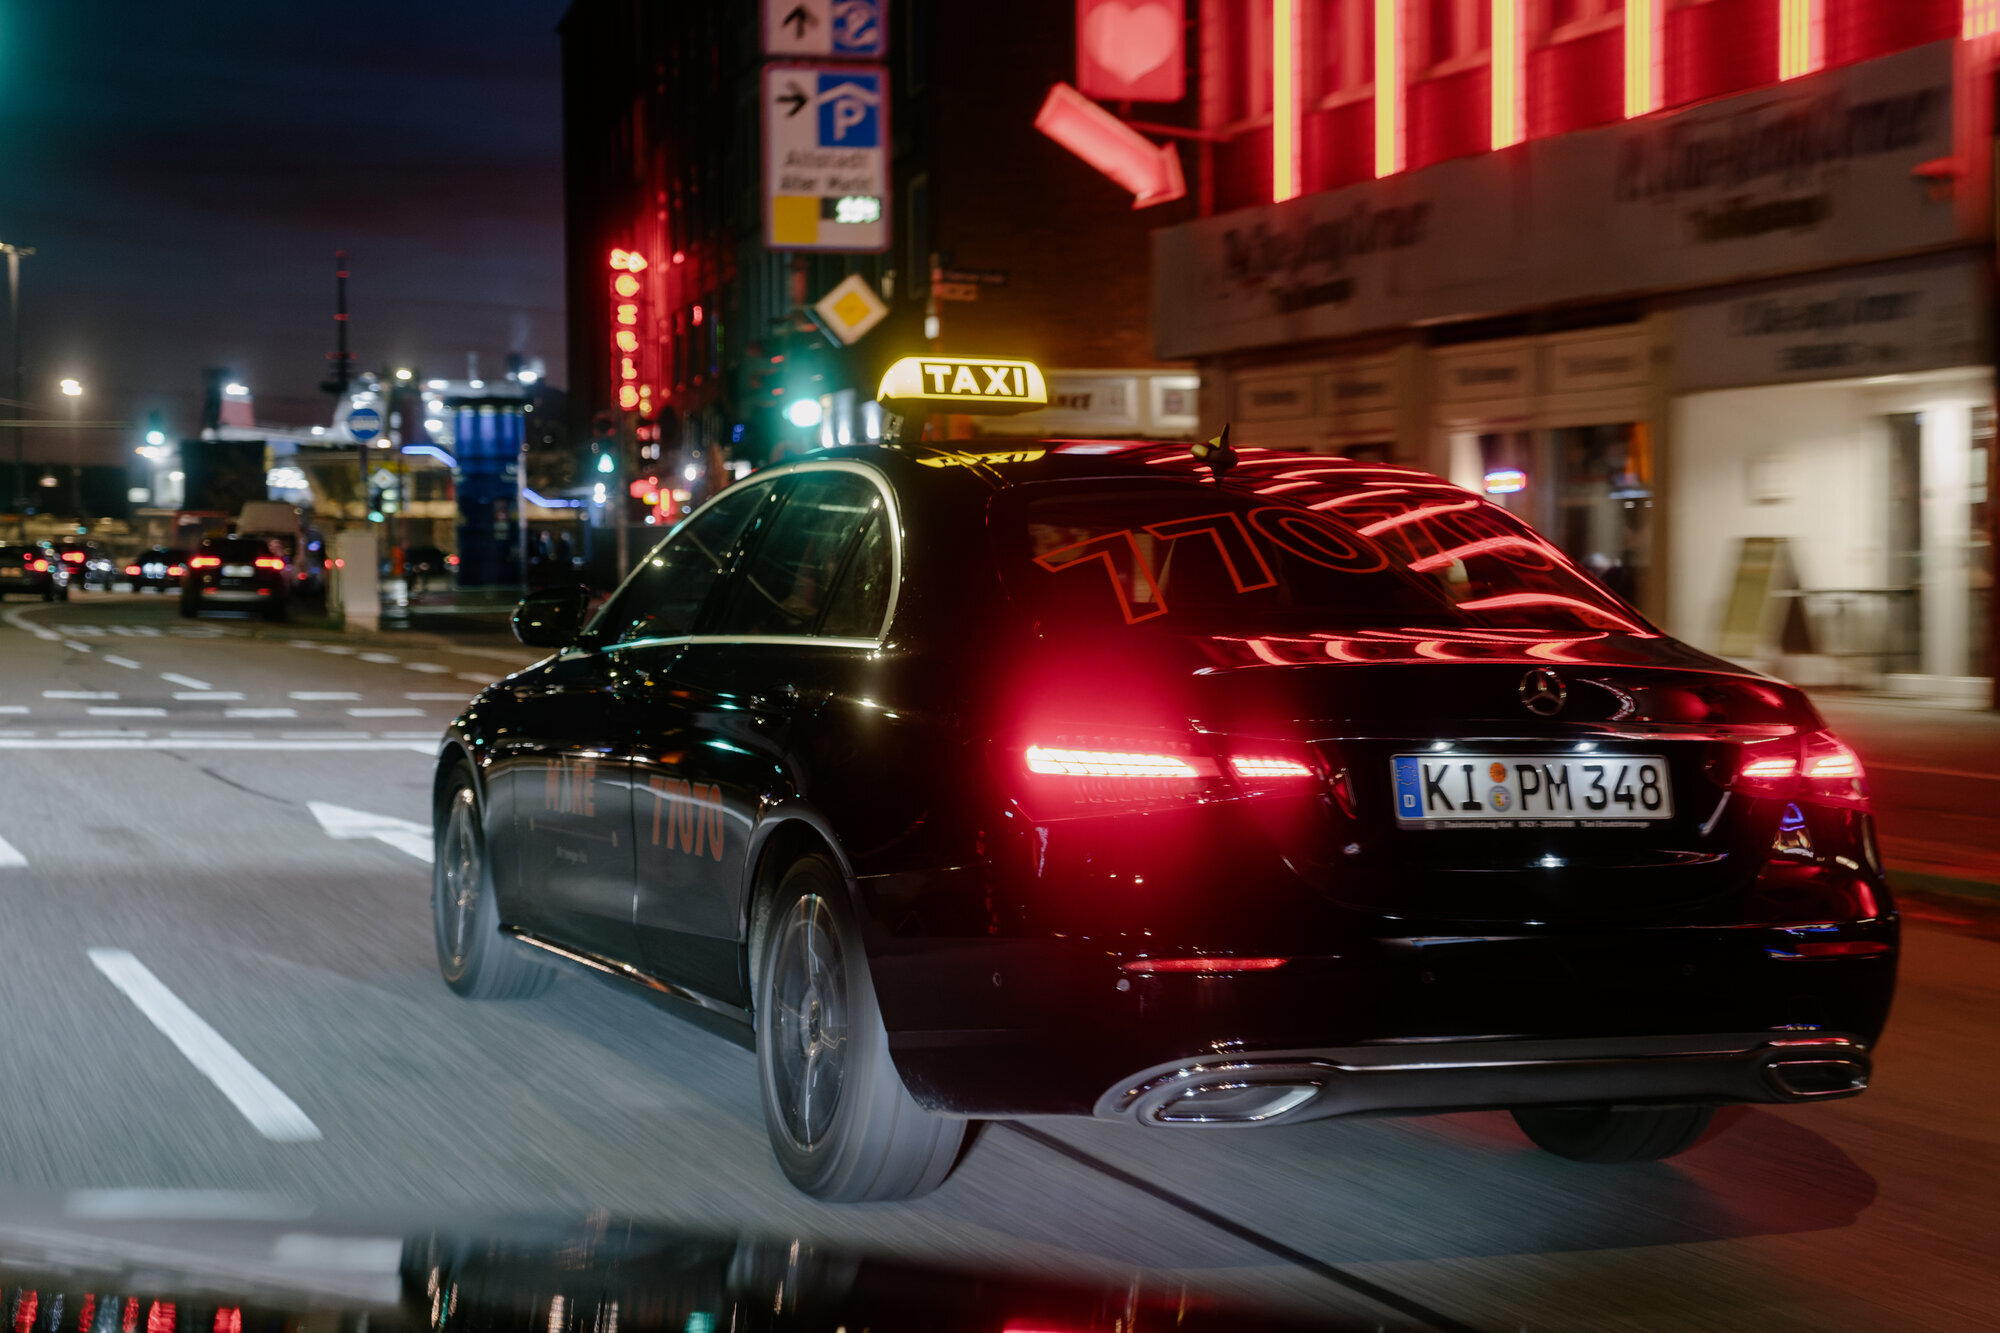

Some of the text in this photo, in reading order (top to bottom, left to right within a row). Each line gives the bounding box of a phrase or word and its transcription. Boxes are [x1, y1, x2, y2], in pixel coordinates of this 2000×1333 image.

[833, 98, 867, 142] P
[924, 364, 1025, 396] TAXI
[1404, 762, 1661, 811] D KI PM 348
[649, 774, 724, 863] 77070
